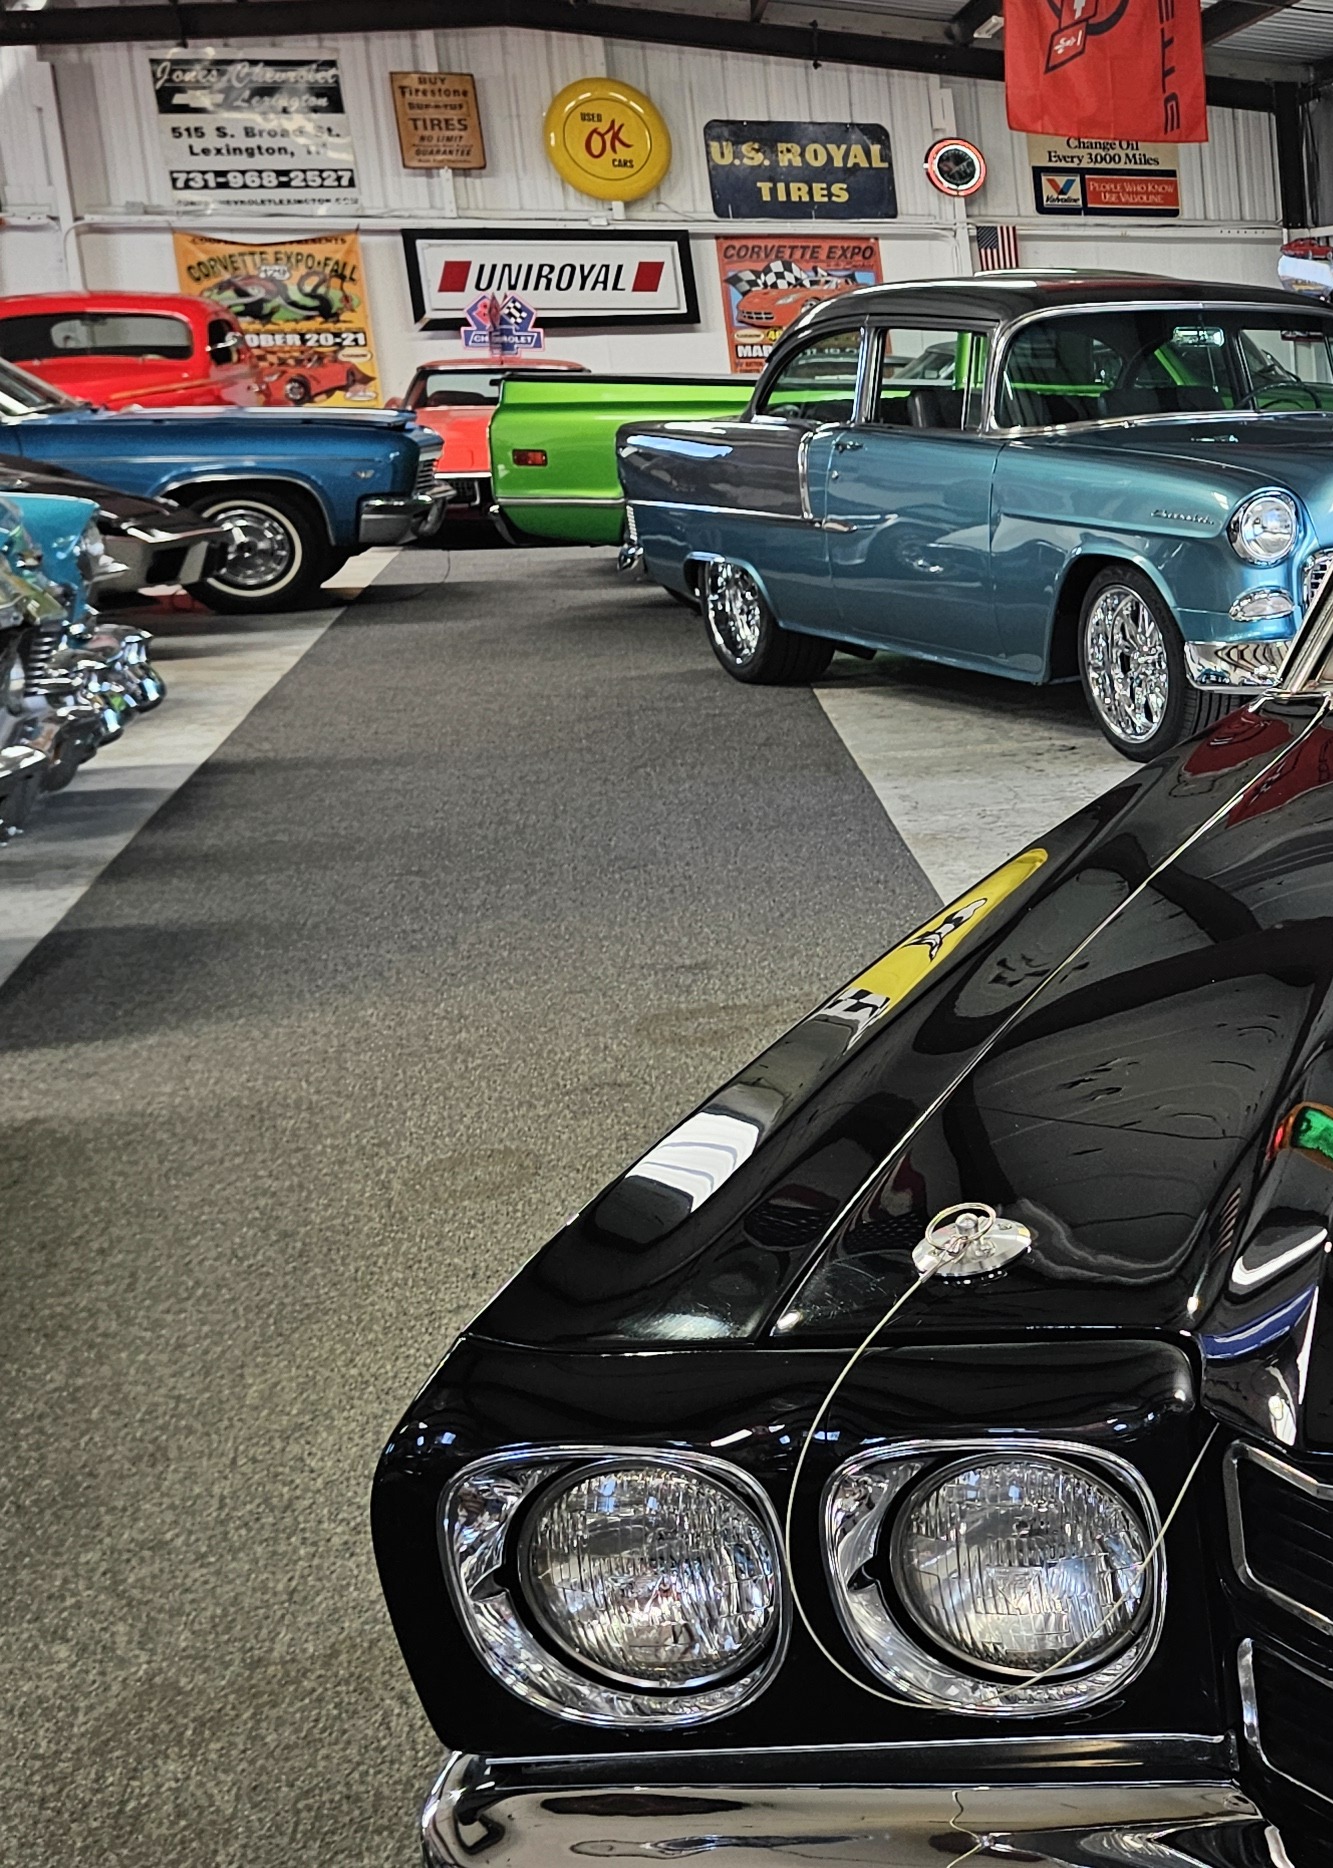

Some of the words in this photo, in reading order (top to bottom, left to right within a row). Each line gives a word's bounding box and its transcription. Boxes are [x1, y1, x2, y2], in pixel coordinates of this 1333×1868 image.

[580, 112, 602, 122] USED
[408, 118, 468, 131] TIRES
[171, 126, 206, 139] 515
[215, 126, 236, 139] S.
[585, 118, 634, 158] OK
[188, 144, 296, 158] Lexington,
[1066, 137, 1117, 151] Change
[1118, 139, 1140, 150] Oil
[710, 141, 770, 166] U.S.
[778, 143, 889, 168] ROYAL
[1047, 151, 1084, 165] Every
[1087, 153, 1121, 165] 3,000
[1124, 154, 1160, 166] Miles
[612, 158, 634, 168] CARS
[173, 171, 352, 188] 731-968-2527
[756, 181, 849, 202] TIRES
[1124, 182, 1146, 192] WHO
[1147, 183, 1174, 192] KNOW
[1101, 192, 1119, 202] USE
[723, 245, 821, 260] CORVETTE
[826, 245, 874, 260] EXPO
[186, 251, 268, 281] CORVETTE
[474, 263, 626, 291] UNIROYAL
[304, 333, 366, 346] 20-21
